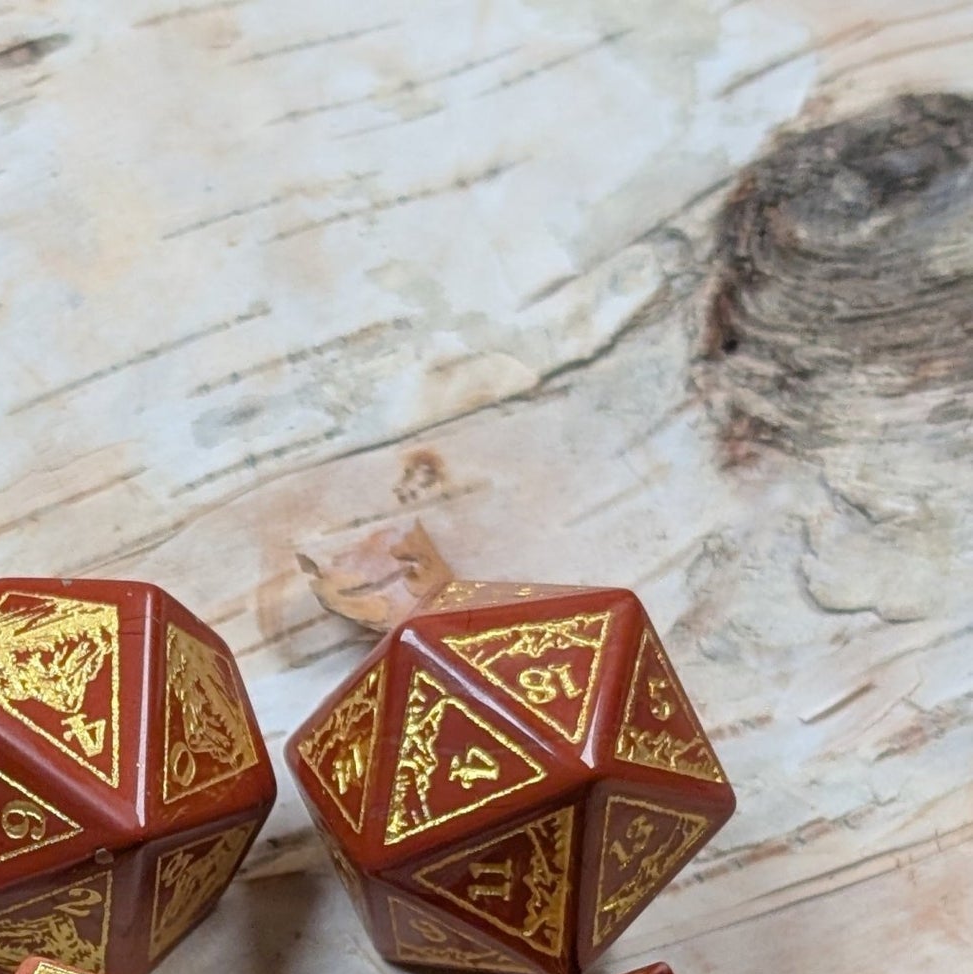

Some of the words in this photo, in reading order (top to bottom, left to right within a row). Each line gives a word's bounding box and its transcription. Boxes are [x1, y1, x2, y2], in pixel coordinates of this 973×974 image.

[519, 664, 584, 705] 18
[647, 677, 675, 721] 5
[60, 713, 106, 757] 4
[169, 741, 197, 787] 0
[448, 746, 500, 790] 4
[1, 799, 47, 841] 6
[610, 815, 655, 870] 13
[467, 858, 514, 901] 11
[53, 887, 103, 918] 2
